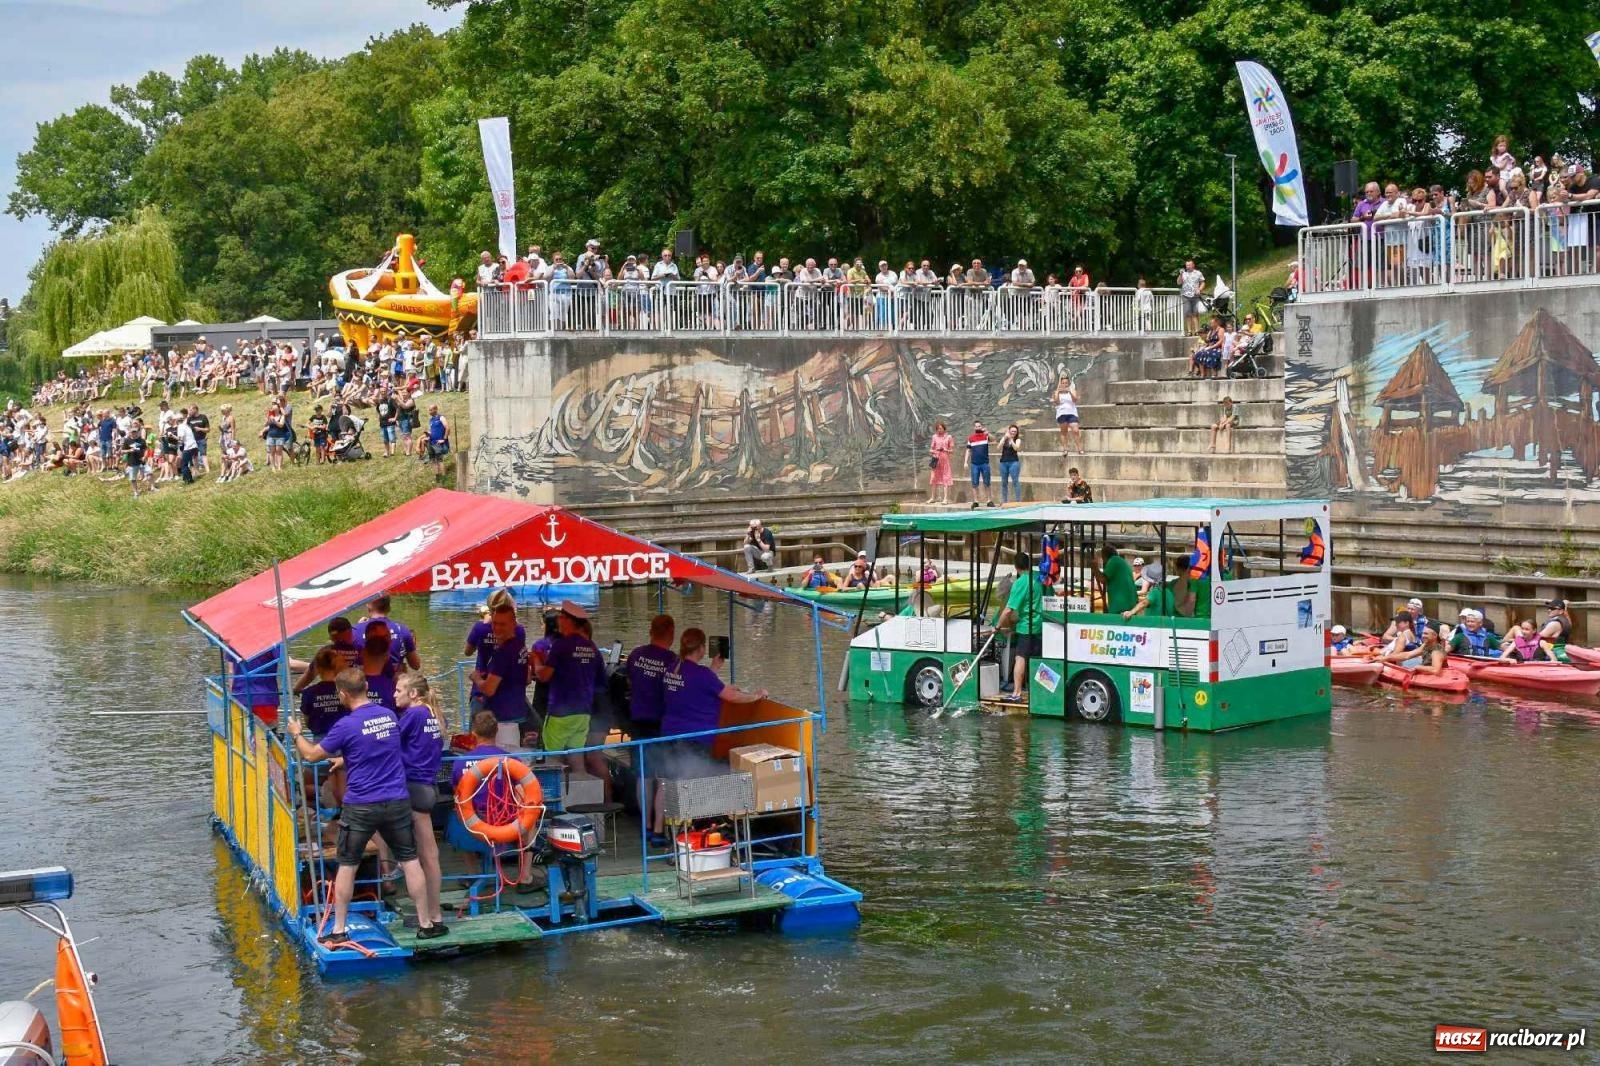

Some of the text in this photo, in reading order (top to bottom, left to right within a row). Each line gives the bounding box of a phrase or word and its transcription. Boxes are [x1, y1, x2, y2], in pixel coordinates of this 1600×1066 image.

[430, 553, 671, 591] BŁAŻEJOWICE
[1079, 628, 1149, 646] BUS Dobrej
[1313, 623, 1322, 635] 11
[1090, 643, 1137, 659] Książki
